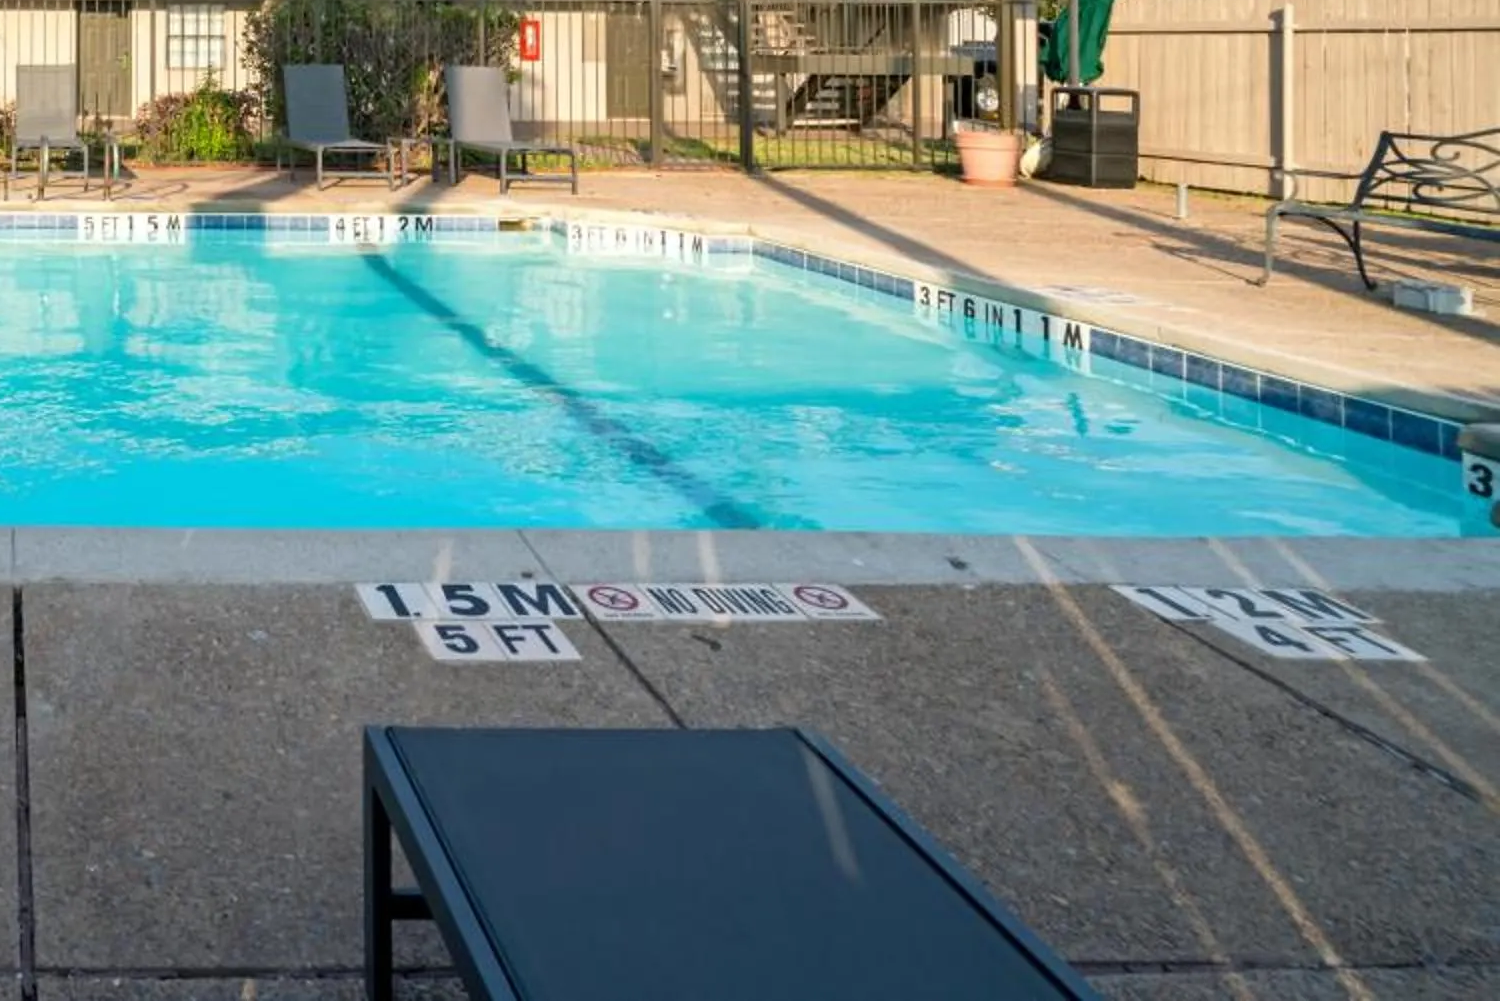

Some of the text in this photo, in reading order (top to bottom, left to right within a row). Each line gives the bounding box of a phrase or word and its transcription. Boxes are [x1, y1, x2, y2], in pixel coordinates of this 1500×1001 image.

[166, 214, 180, 230] M
[415, 216, 432, 231] M
[920, 286, 930, 306] 3
[938, 290, 956, 312] FT
[964, 298, 975, 319] 6
[985, 303, 1003, 328] IN
[1063, 323, 1083, 350] M
[1468, 463, 1493, 498] 3
[647, 588, 795, 614] NO DIVING
[435, 624, 560, 654] 5 FT
[1254, 625, 1397, 654] 4 FT
